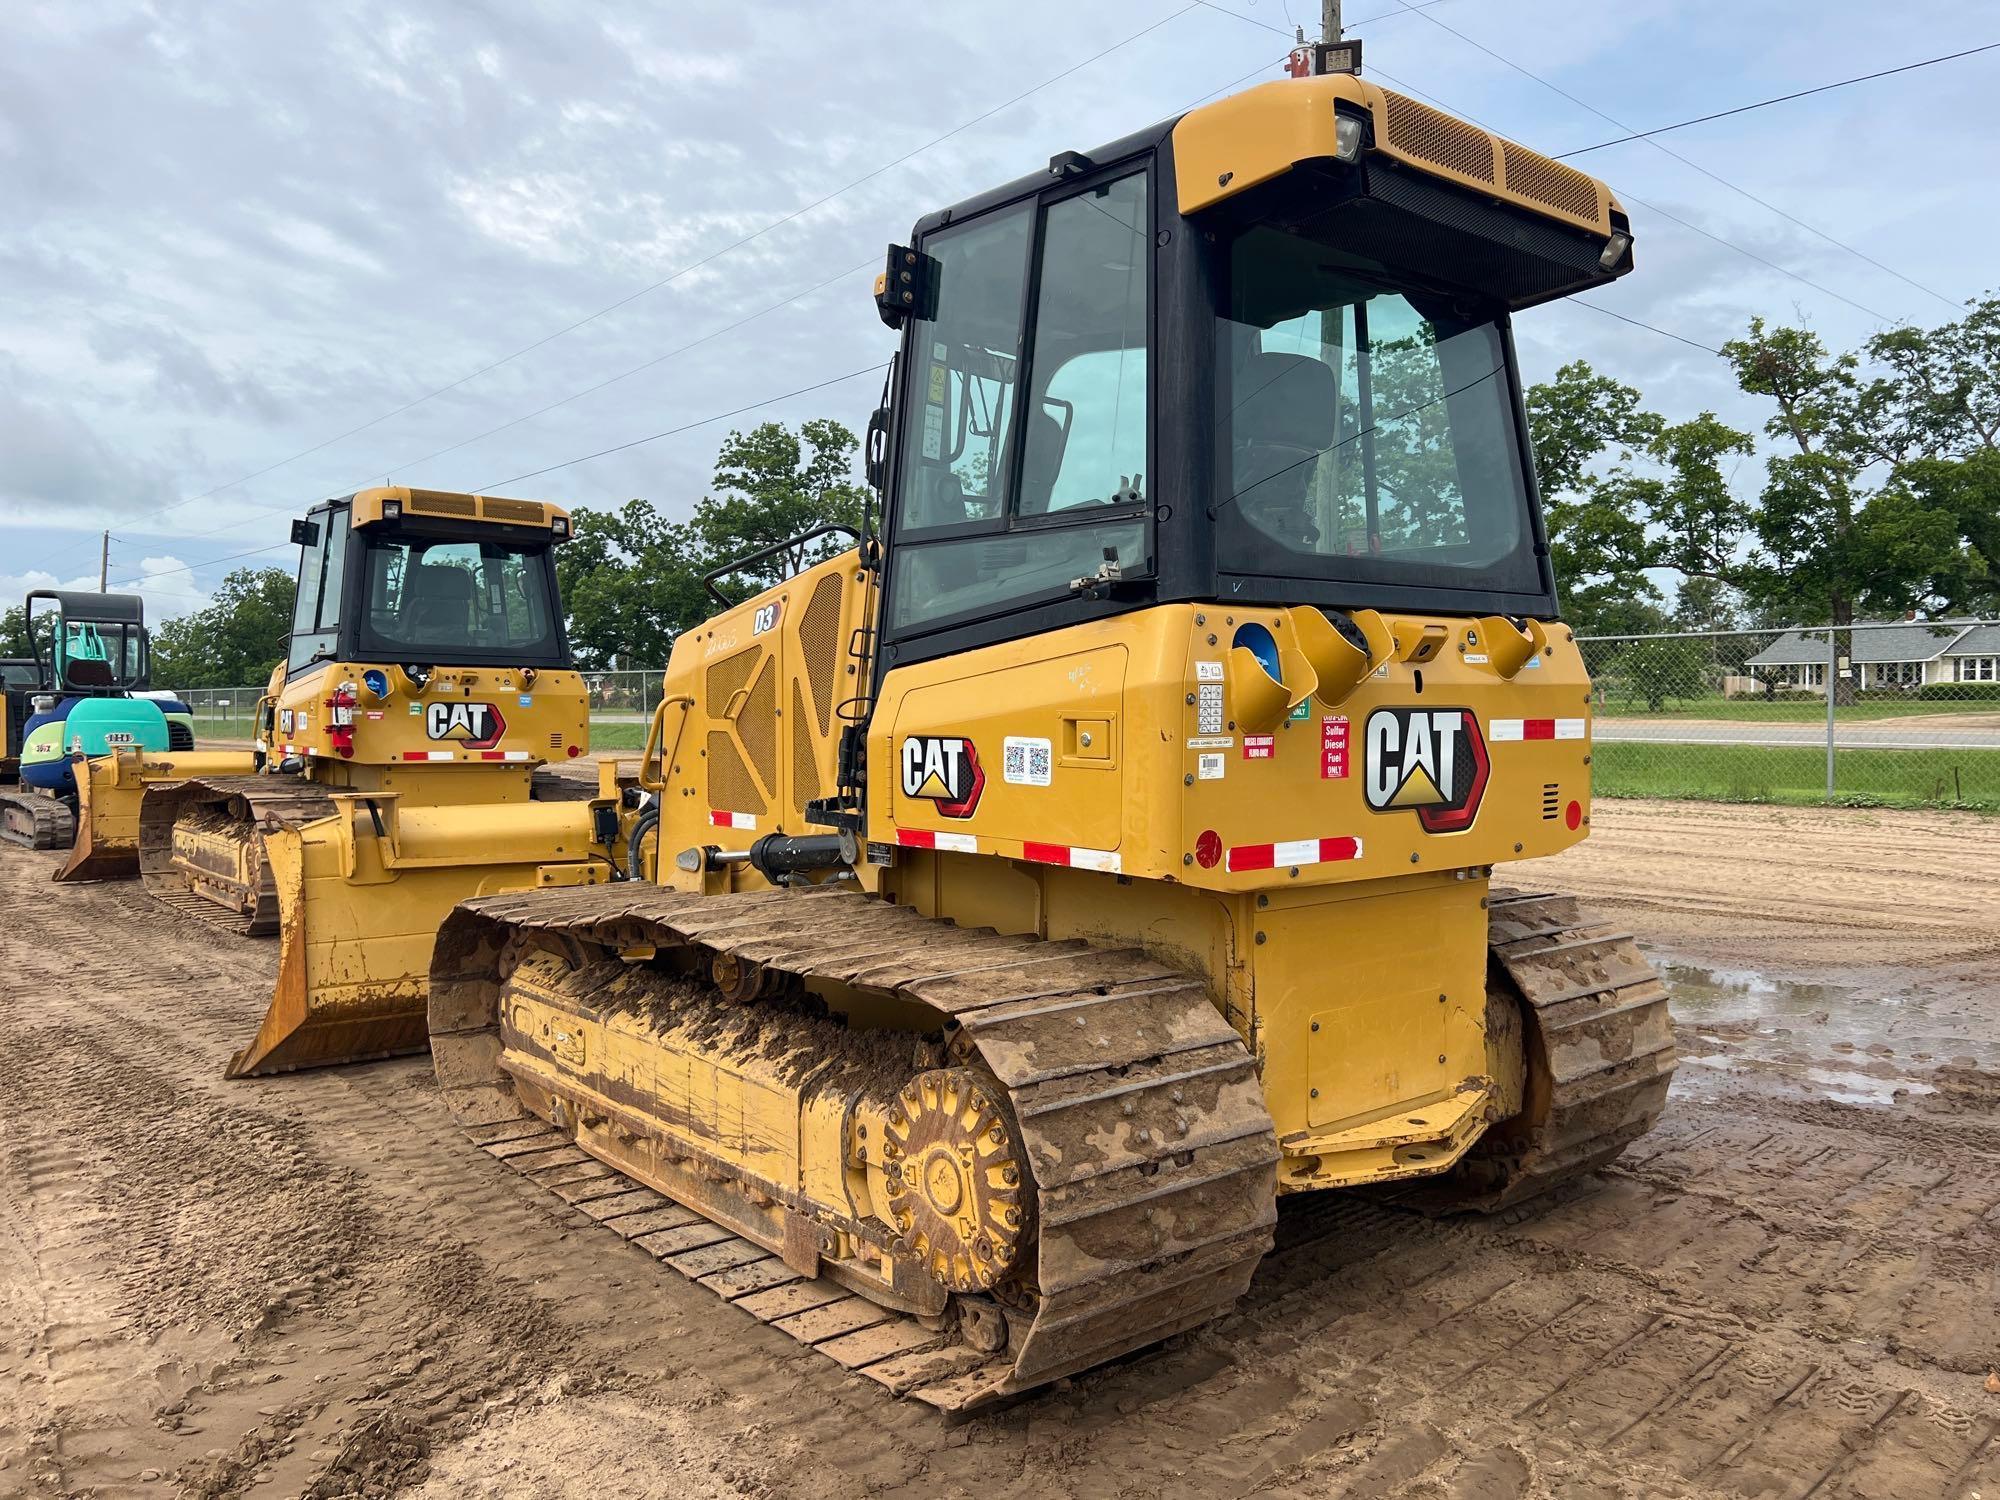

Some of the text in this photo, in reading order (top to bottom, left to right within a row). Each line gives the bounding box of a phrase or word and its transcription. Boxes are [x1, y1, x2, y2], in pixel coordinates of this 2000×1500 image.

[753, 605, 774, 636] D3
[428, 703, 488, 739] CAT
[1325, 725, 1346, 736] Sulfur
[1324, 739, 1346, 749] Diesel
[903, 737, 963, 799] CAT
[1327, 752, 1342, 763] Fuel
[1366, 711, 1462, 807] CAT
[1327, 766, 1342, 774] ONLY
